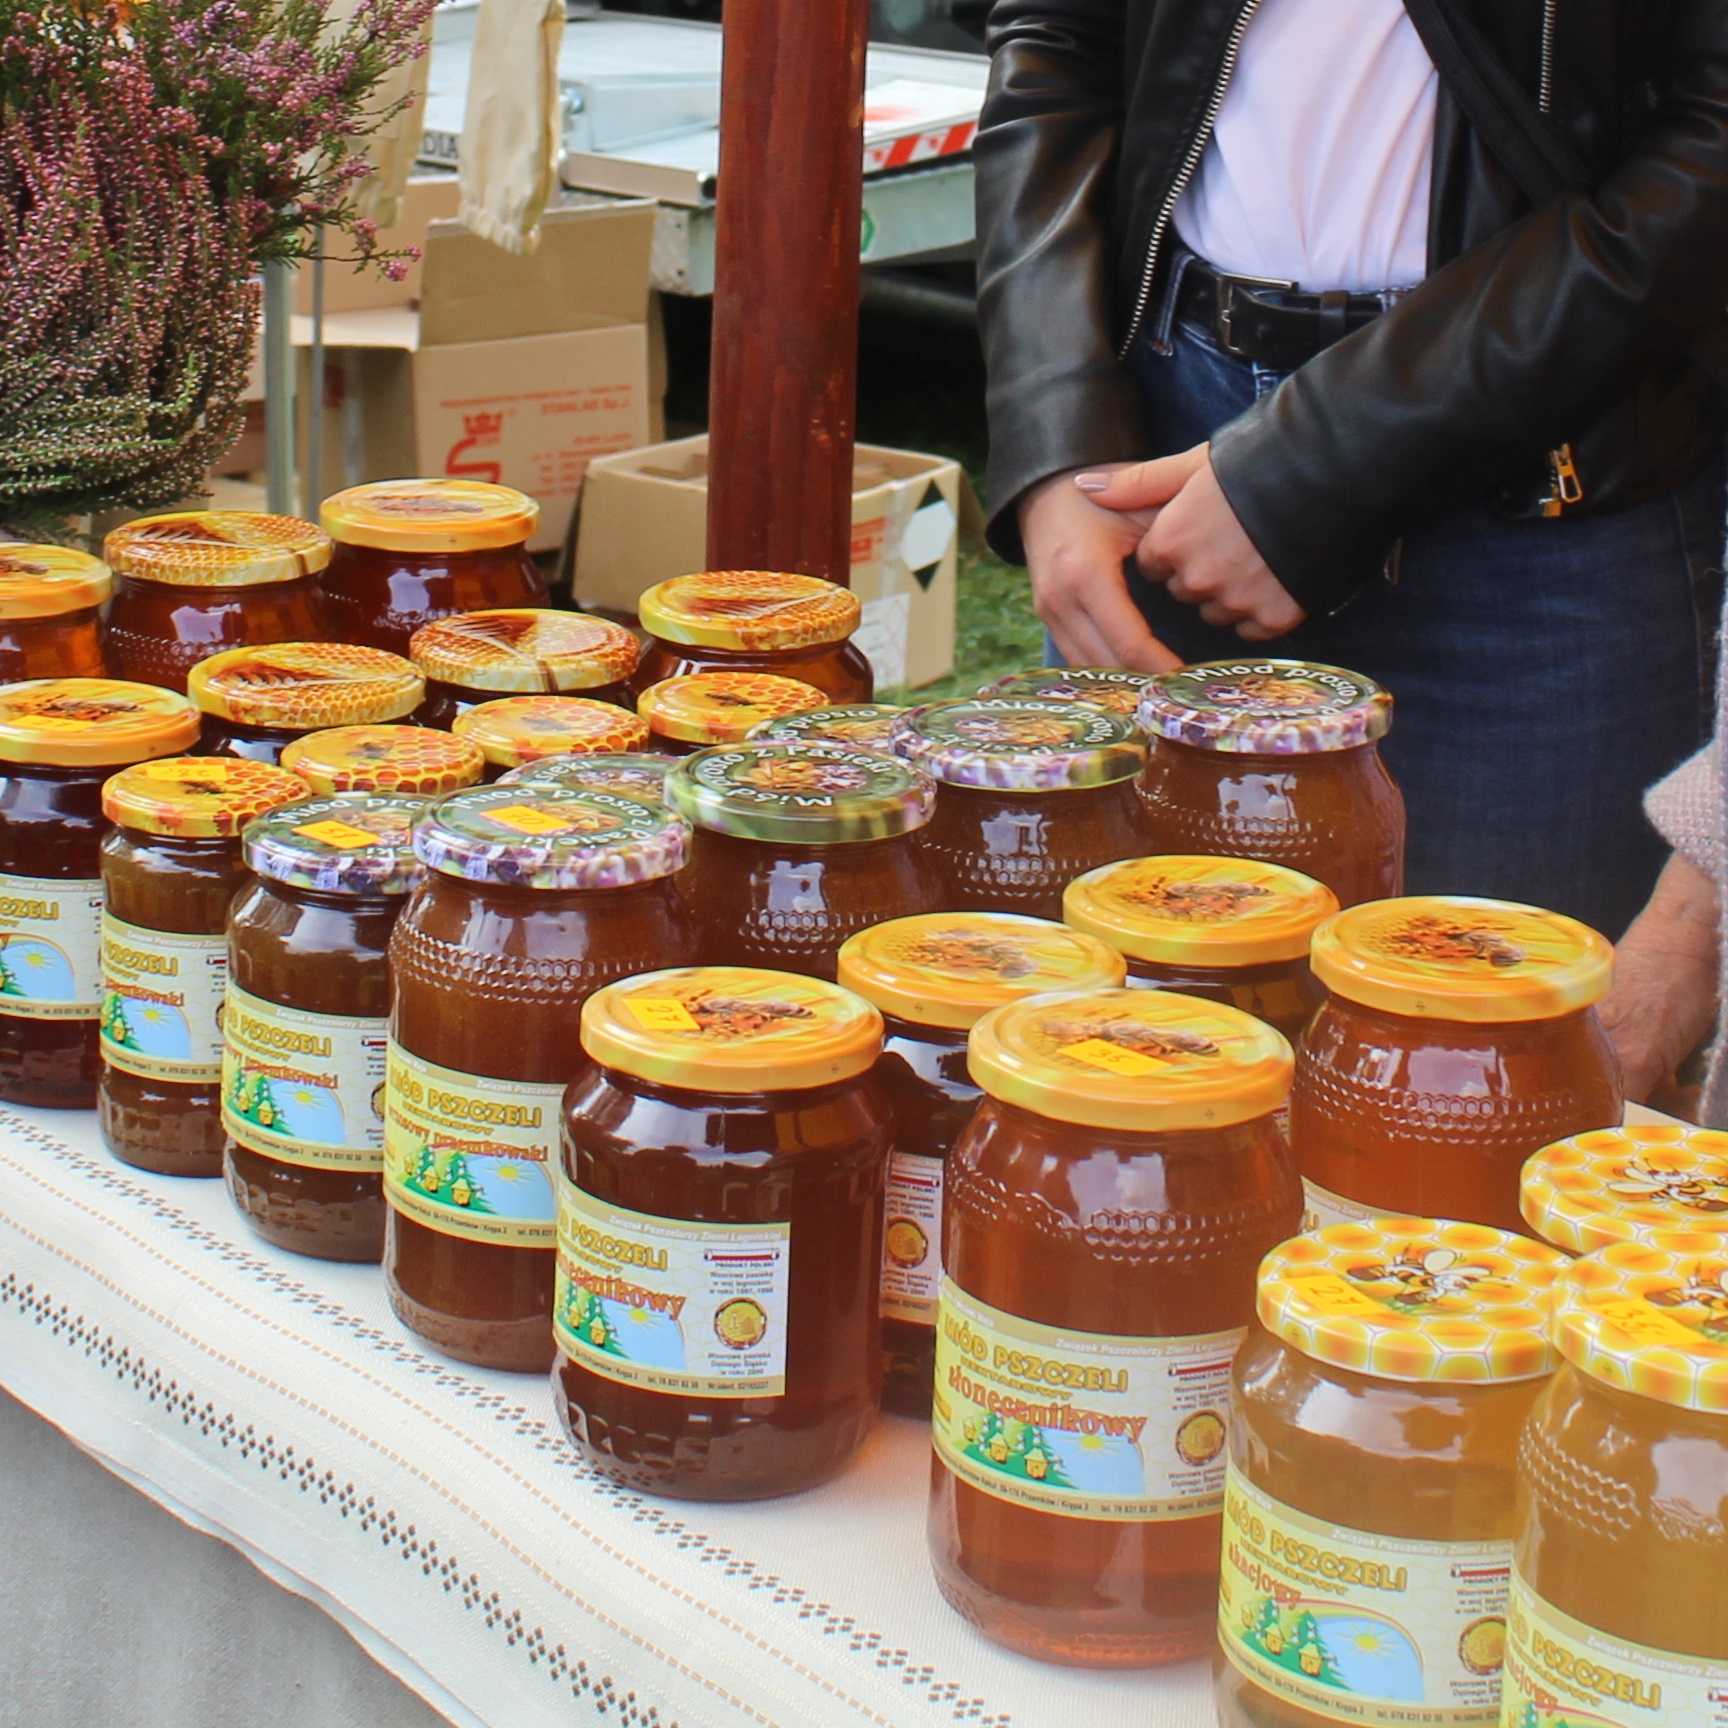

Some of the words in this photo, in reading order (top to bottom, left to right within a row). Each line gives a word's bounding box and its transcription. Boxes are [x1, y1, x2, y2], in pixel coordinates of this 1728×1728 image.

[785, 744, 893, 774] Pasieki
[551, 787, 653, 818] prosto
[104, 939, 179, 977] SZCZELI
[240, 1014, 333, 1058] PSZCZELI
[428, 1088, 543, 1129] PSZCZELI
[571, 1219, 668, 1272] PSZCZELI
[944, 1313, 989, 1361] MIÓD
[993, 1344, 1130, 1394] PSZCZELI
[948, 1365, 1149, 1445] słonecznikowy
[1227, 1489, 1266, 1544] MIÓD
[1270, 1529, 1408, 1593] PSZCZELI
[1532, 1629, 1662, 1711] PSZCZELI
